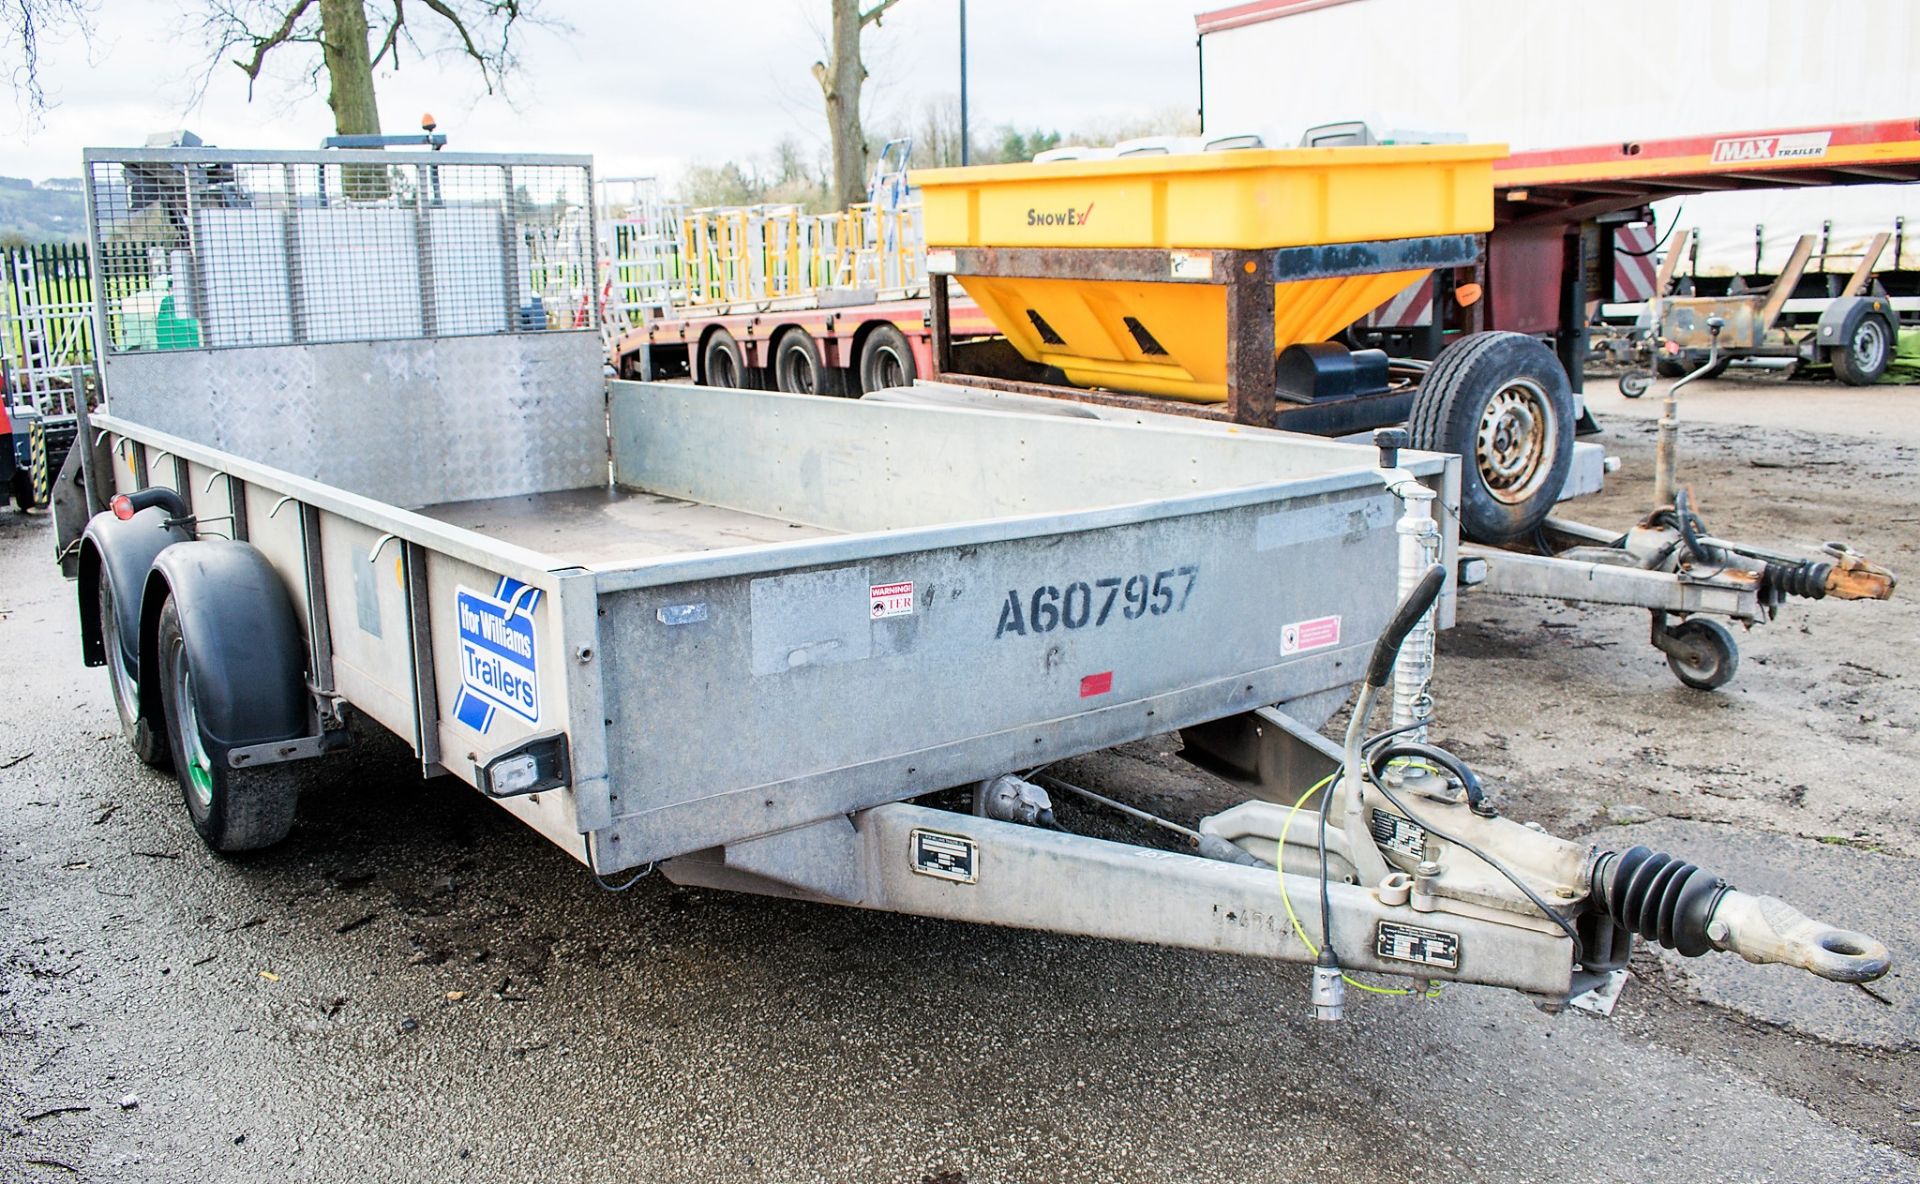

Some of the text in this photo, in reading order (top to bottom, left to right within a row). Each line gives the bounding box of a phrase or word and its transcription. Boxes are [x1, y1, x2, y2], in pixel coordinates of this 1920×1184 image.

[1718, 139, 1823, 161] MAX TRAILER
[872, 584, 912, 597] WARNING!
[995, 565, 1199, 639] A607957
[460, 601, 533, 660] Ifor Williams
[464, 644, 534, 709] Trailers
